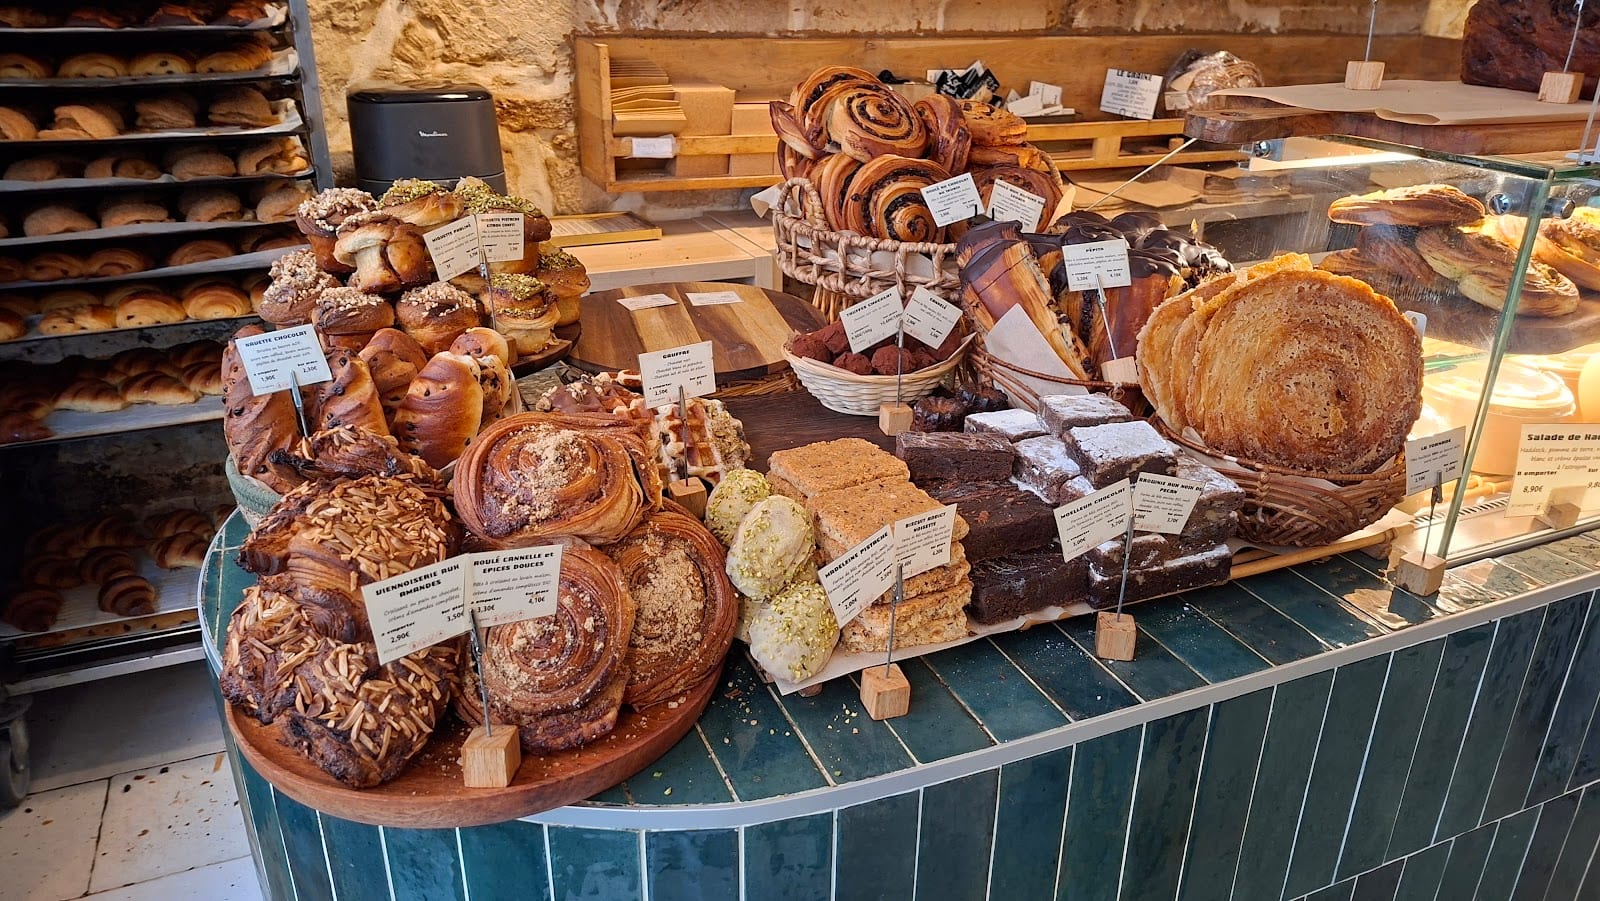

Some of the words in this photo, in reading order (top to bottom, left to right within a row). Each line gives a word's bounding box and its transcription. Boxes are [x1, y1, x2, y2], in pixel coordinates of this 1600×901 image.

[245, 338, 272, 348] NAVETTE
[273, 330, 307, 342] CHOCOLAT
[1527, 433, 1565, 441] Salade
[1568, 433, 1581, 441] de
[1094, 487, 1125, 504] CHOCOLAT
[474, 556, 499, 566] ROULÉ
[503, 554, 541, 562] CANNELLE
[825, 552, 858, 579] MADELEINE
[860, 532, 888, 555] PISTACHE
[483, 565, 510, 573] EPICES
[514, 562, 544, 570] DOUCES
[375, 571, 437, 596] VIENNOISERIE
[441, 563, 459, 575] AUX
[399, 579, 441, 598] AMANDES
[391, 630, 410, 644] 2,90€
